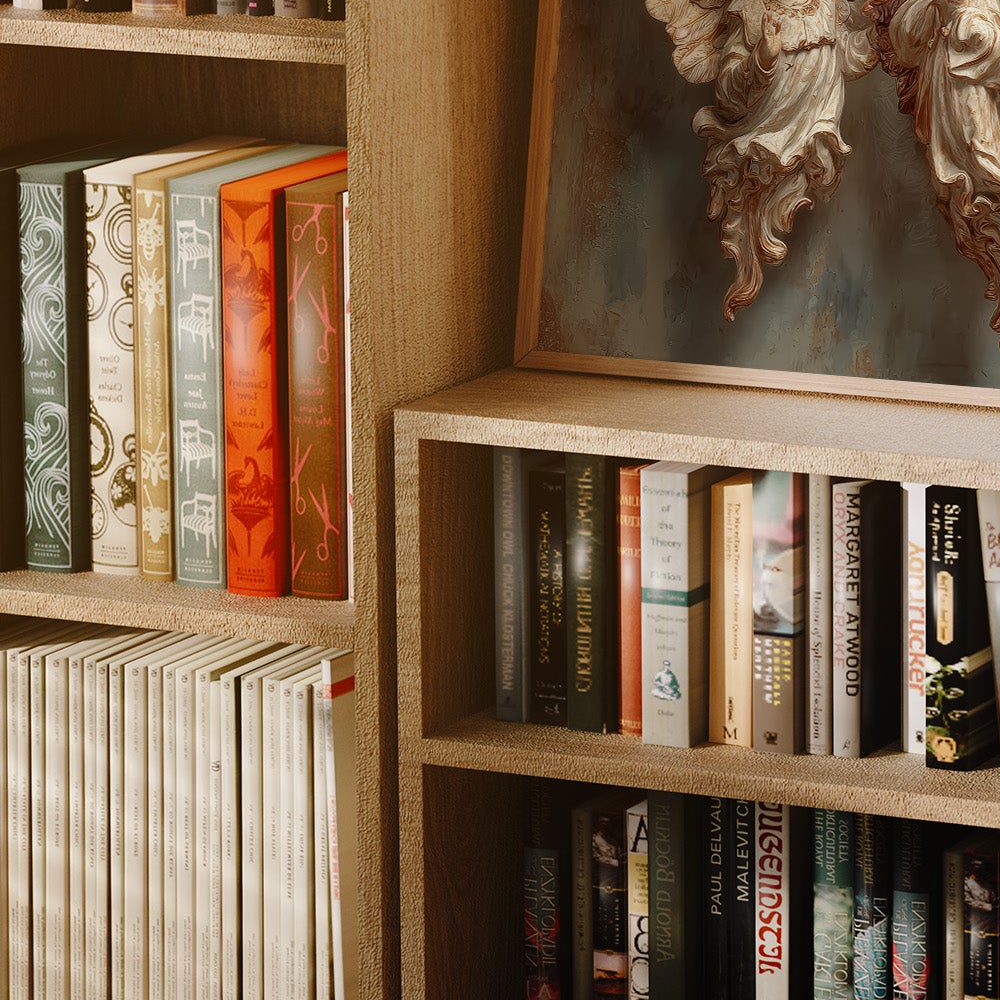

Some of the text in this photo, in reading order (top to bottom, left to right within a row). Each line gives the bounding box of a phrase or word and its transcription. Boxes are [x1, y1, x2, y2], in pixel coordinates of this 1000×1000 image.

[502, 454, 513, 689] DOWNTOWN OWL CHUCK KLOSTERMAN
[650, 570, 681, 581] Fiction
[651, 537, 681, 549] Theory
[833, 492, 845, 668] ORYX AND CRAKE
[845, 493, 860, 697] MARGARET ATWOOD
[710, 871, 722, 915] PAUL
